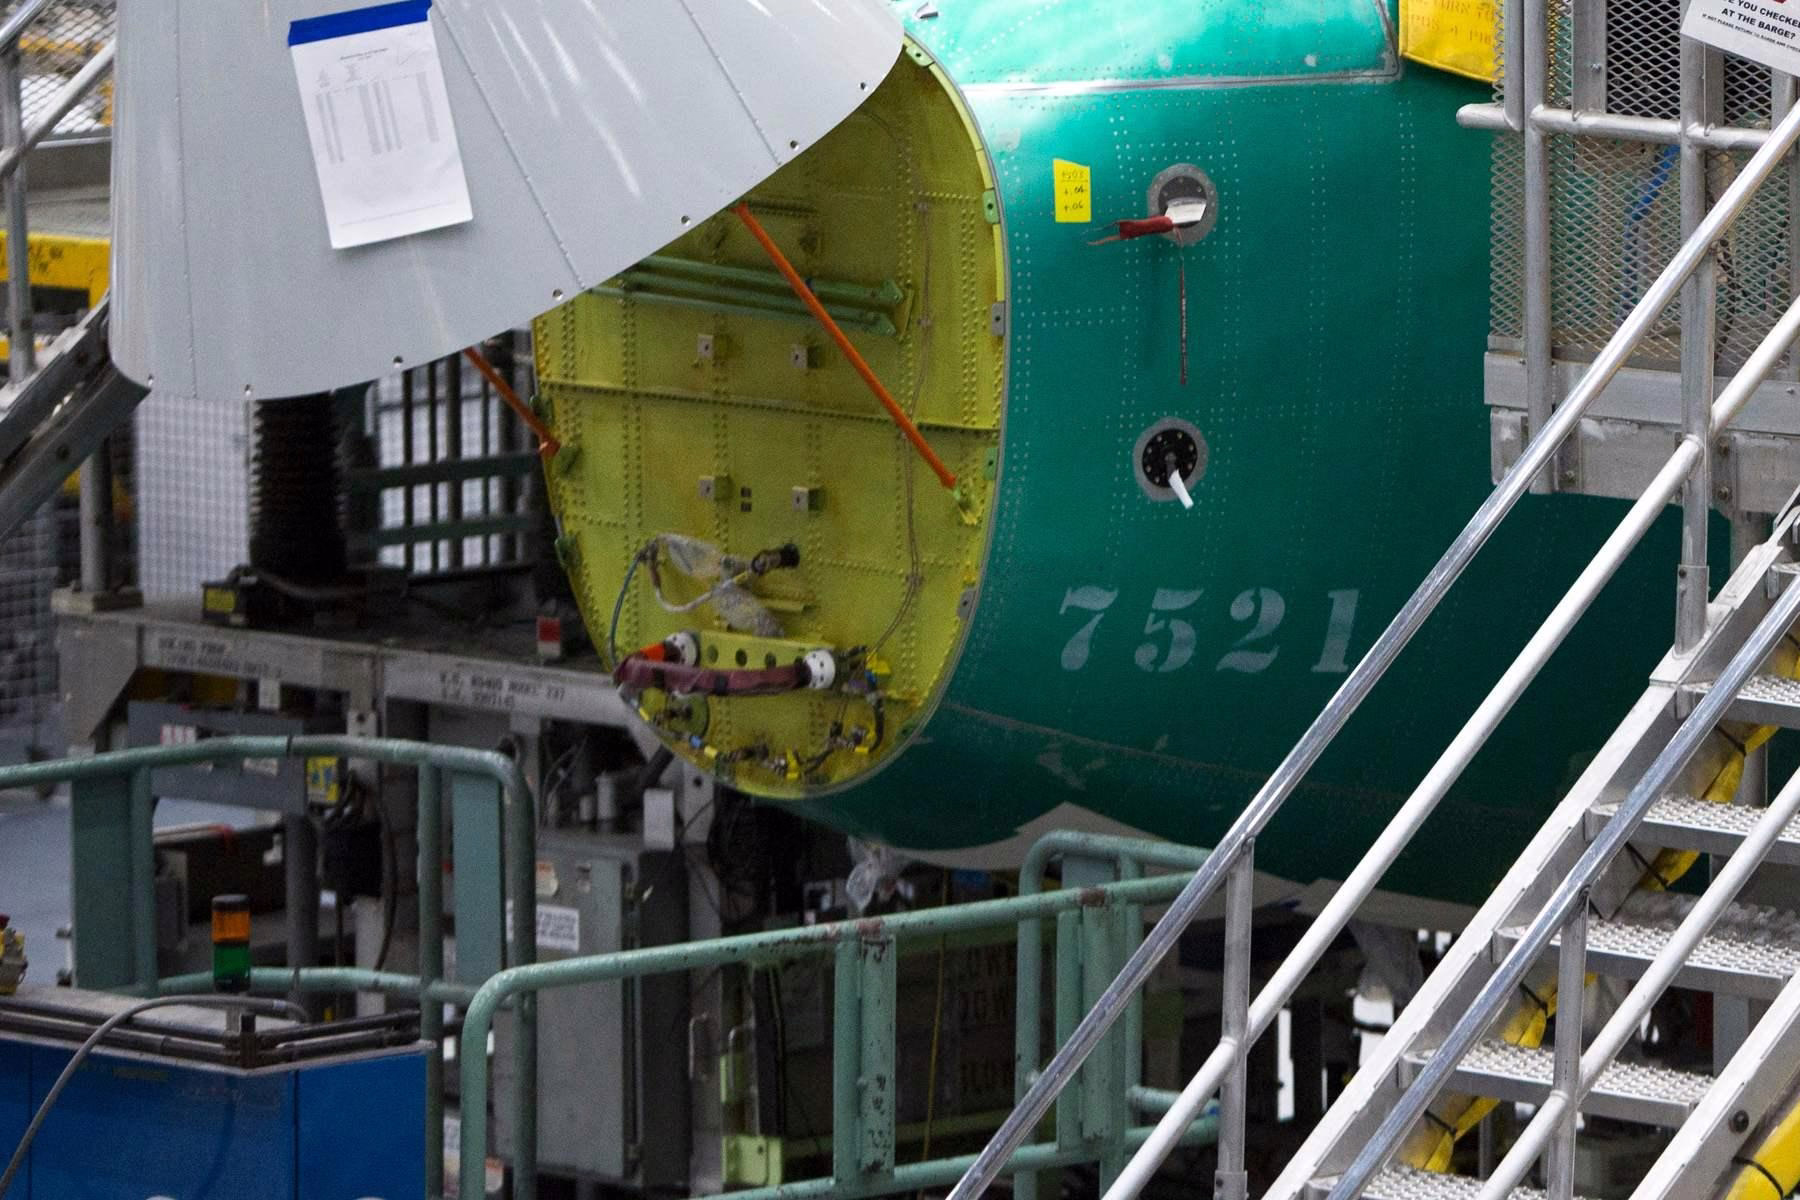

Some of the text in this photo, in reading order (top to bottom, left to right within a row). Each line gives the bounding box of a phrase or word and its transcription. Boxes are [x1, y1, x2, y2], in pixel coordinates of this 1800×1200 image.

[1738, 0, 1758, 12] YOU
[1721, 7, 1796, 40] AT THE BARGE?
[1058, 586, 1360, 673] 7521
